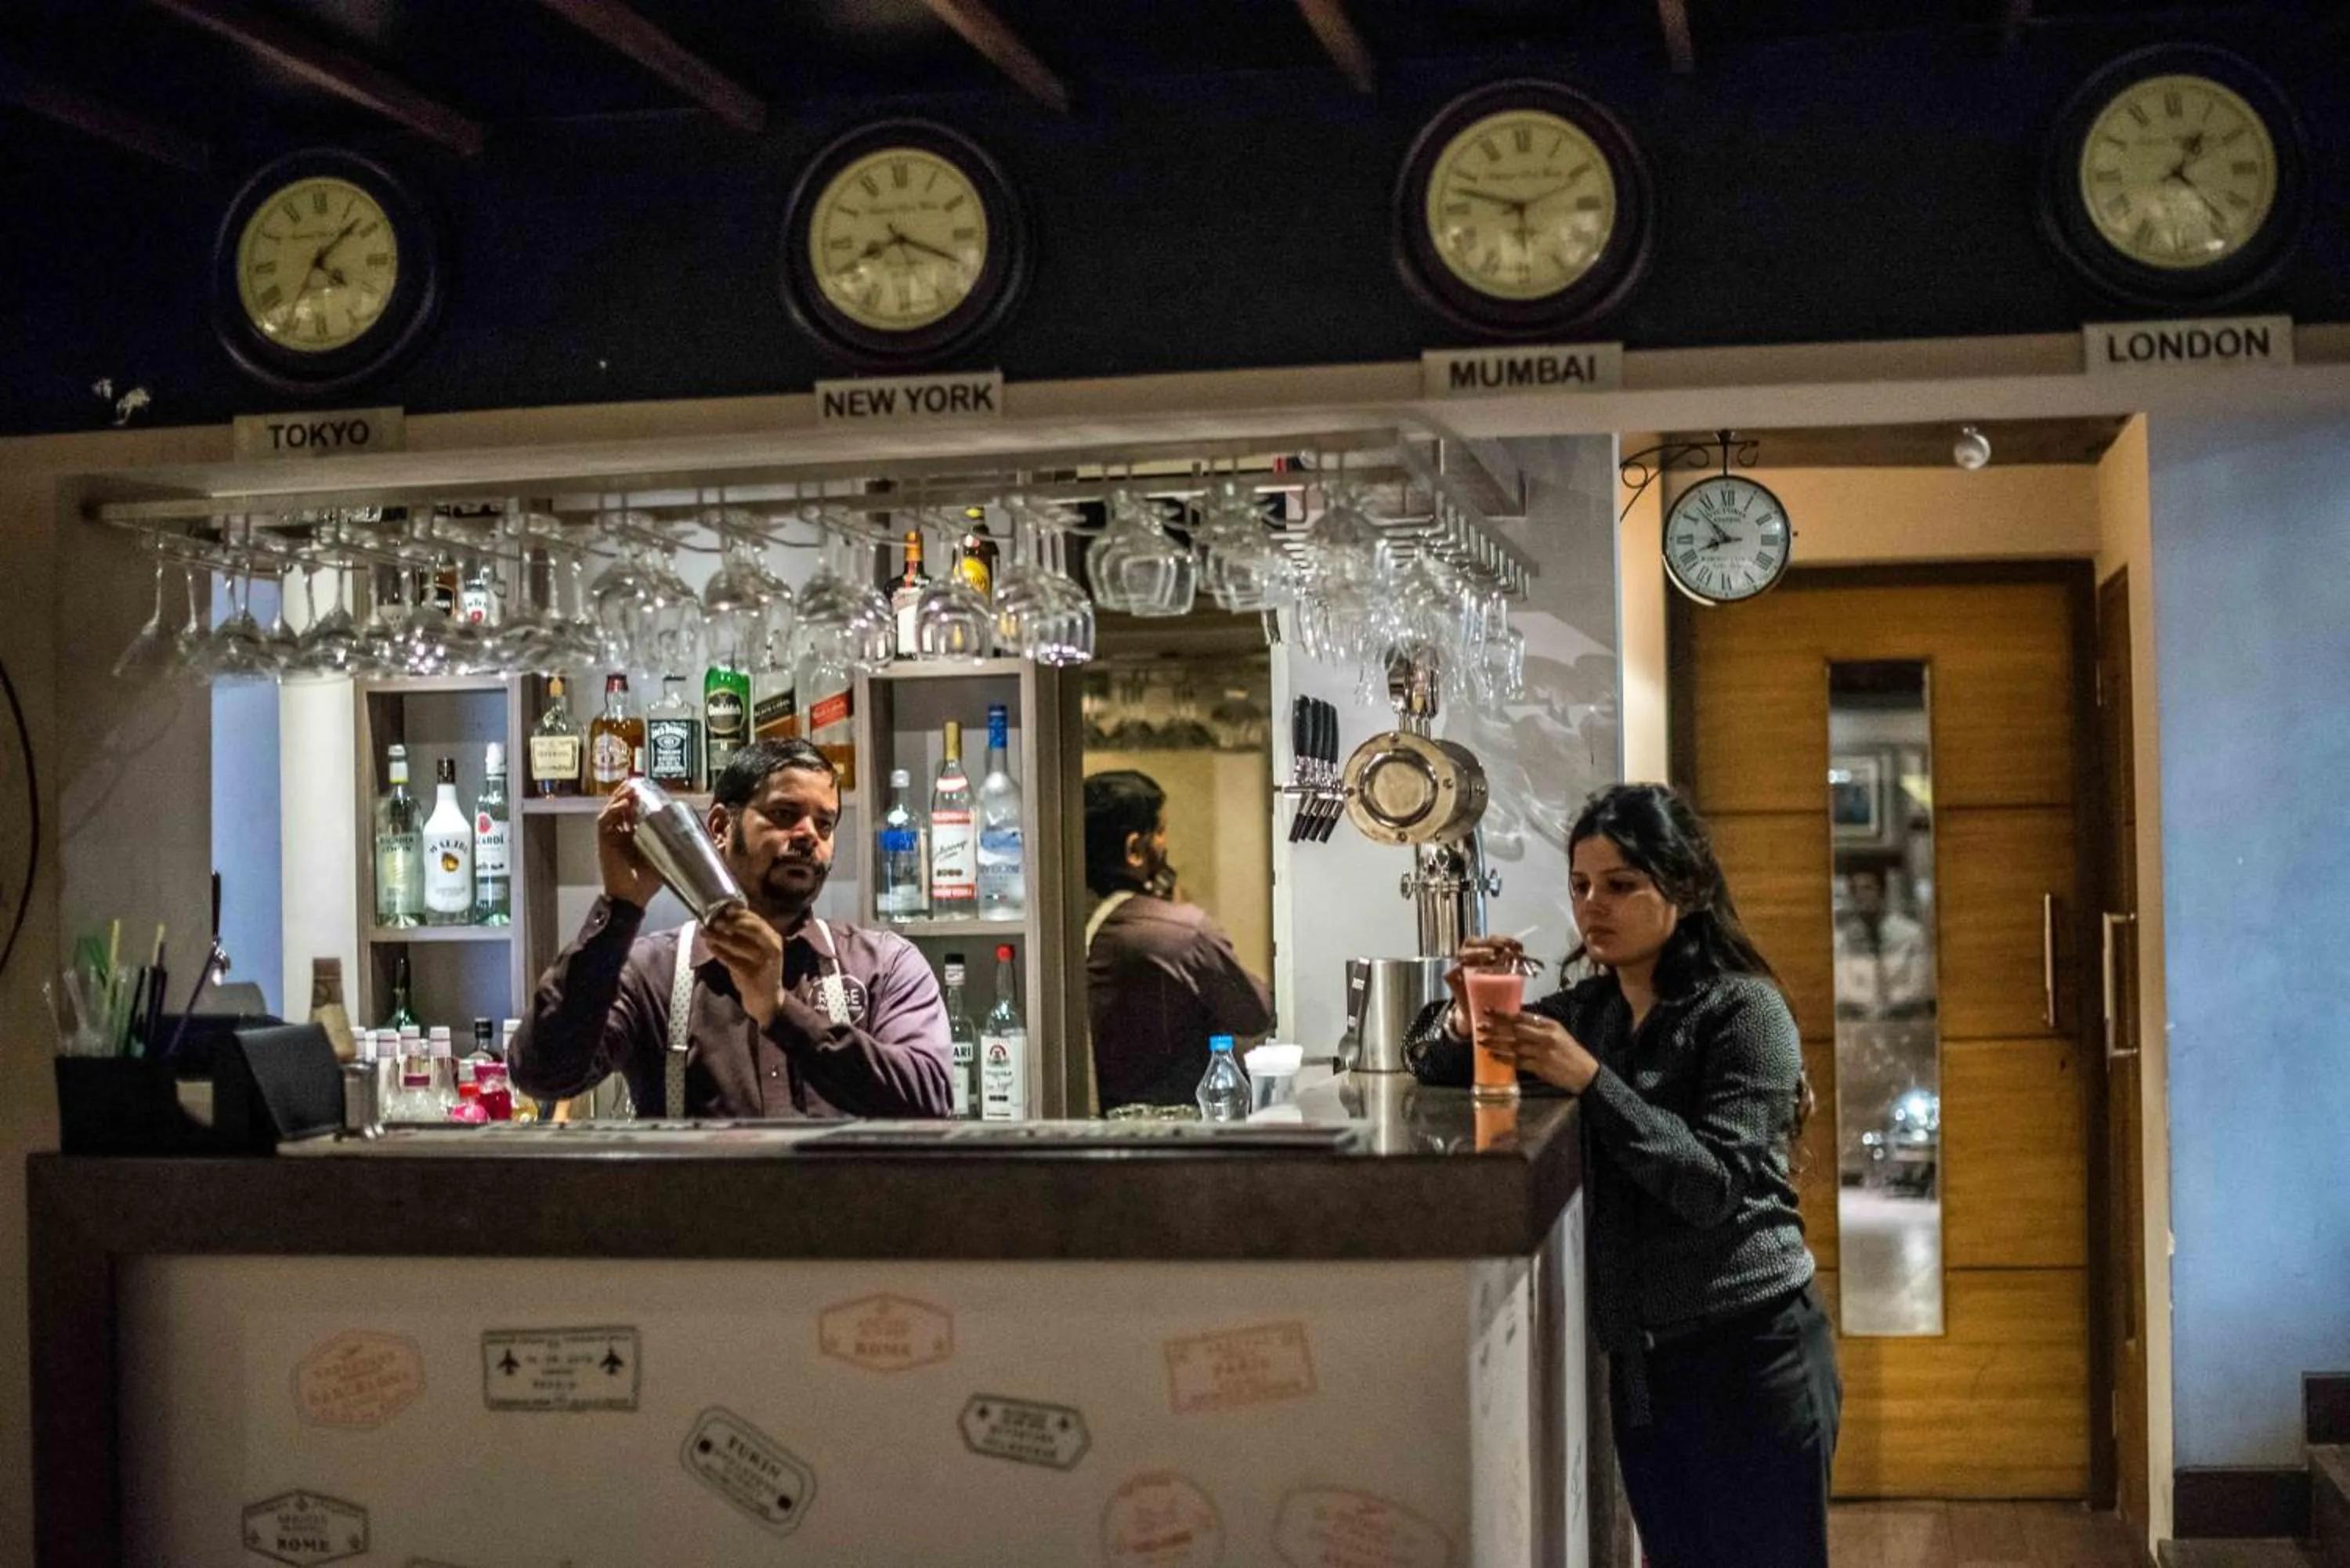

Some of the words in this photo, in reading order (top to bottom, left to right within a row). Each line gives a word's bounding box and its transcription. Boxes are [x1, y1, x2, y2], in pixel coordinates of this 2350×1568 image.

[2107, 326, 2270, 363] LONDON
[1451, 355, 1596, 388] MUMBAI
[825, 388, 896, 418] NEW
[904, 383, 994, 414] YORK
[267, 419, 370, 450] TOKYO
[277, 1537, 331, 1552] ROME
